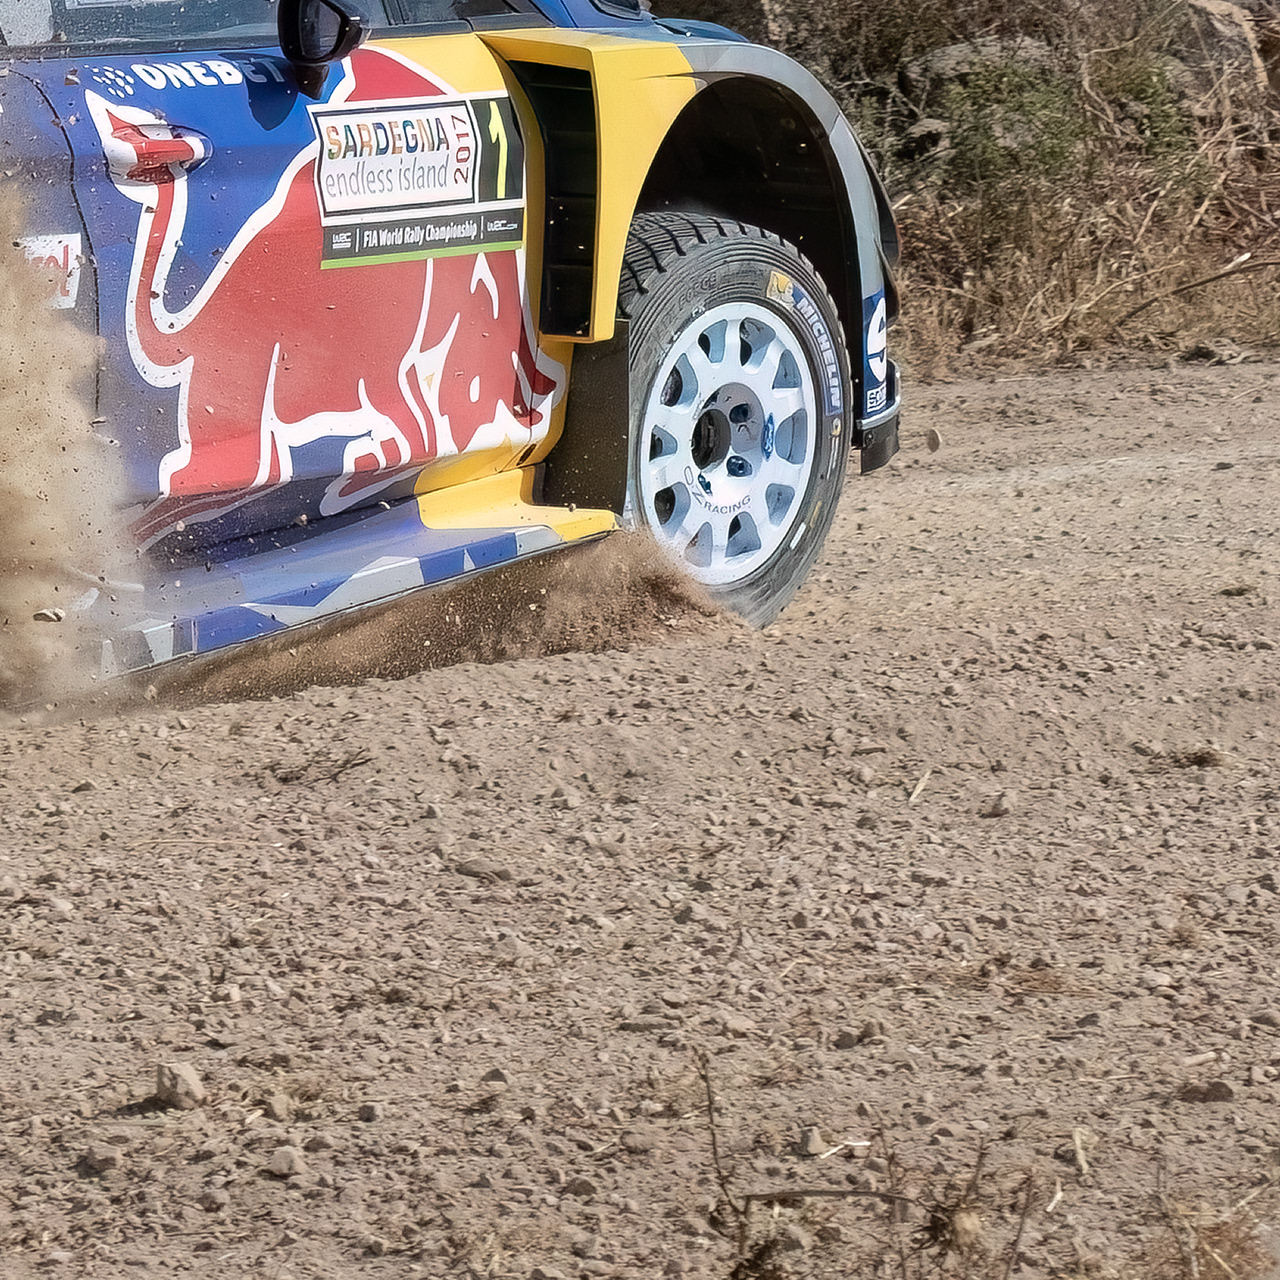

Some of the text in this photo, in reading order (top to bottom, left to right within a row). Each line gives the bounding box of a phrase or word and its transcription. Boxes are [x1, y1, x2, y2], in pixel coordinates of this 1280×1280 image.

[130, 59, 285, 90] ONEBET
[326, 118, 450, 160] SARDEGNA
[451, 115, 471, 185] 2017
[488, 101, 508, 199] 1
[326, 154, 450, 197] endless island
[363, 230, 378, 248] FIA
[379, 226, 403, 246] World
[404, 225, 425, 246] Rally
[425, 220, 478, 243] Championship
[795, 297, 842, 412] MICHELIN
[704, 495, 751, 515] RACING
